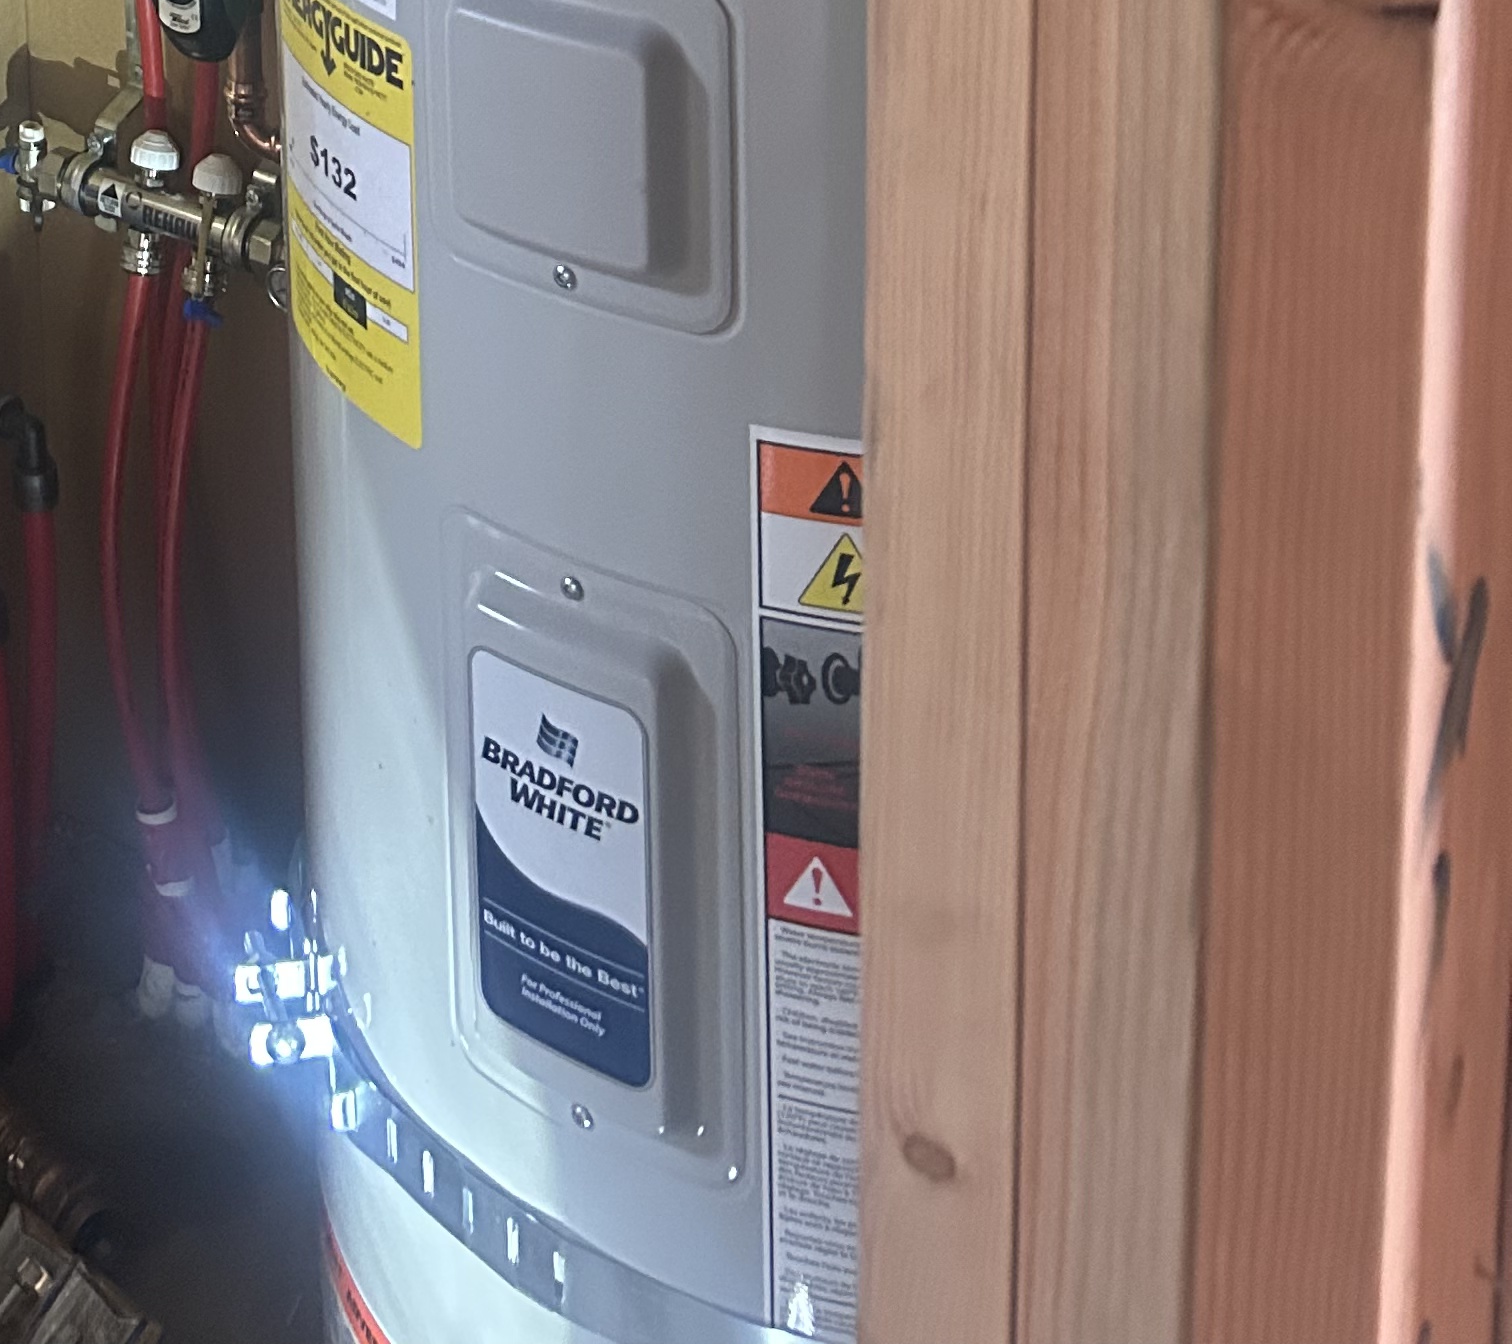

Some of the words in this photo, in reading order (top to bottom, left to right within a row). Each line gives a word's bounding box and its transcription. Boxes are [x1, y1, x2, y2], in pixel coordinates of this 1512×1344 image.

[309, 134, 358, 201] $132
[481, 735, 640, 825] BRADFORD
[510, 776, 604, 842] WHITE
[483, 908, 517, 940] Built
[519, 931, 536, 949] to
[539, 940, 561, 963] be
[565, 953, 593, 979] the
[596, 968, 638, 999] Best
[521, 972, 538, 991] For
[538, 982, 603, 1022] Professional
[521, 985, 580, 1024] Installation
[579, 1016, 606, 1038] Only
